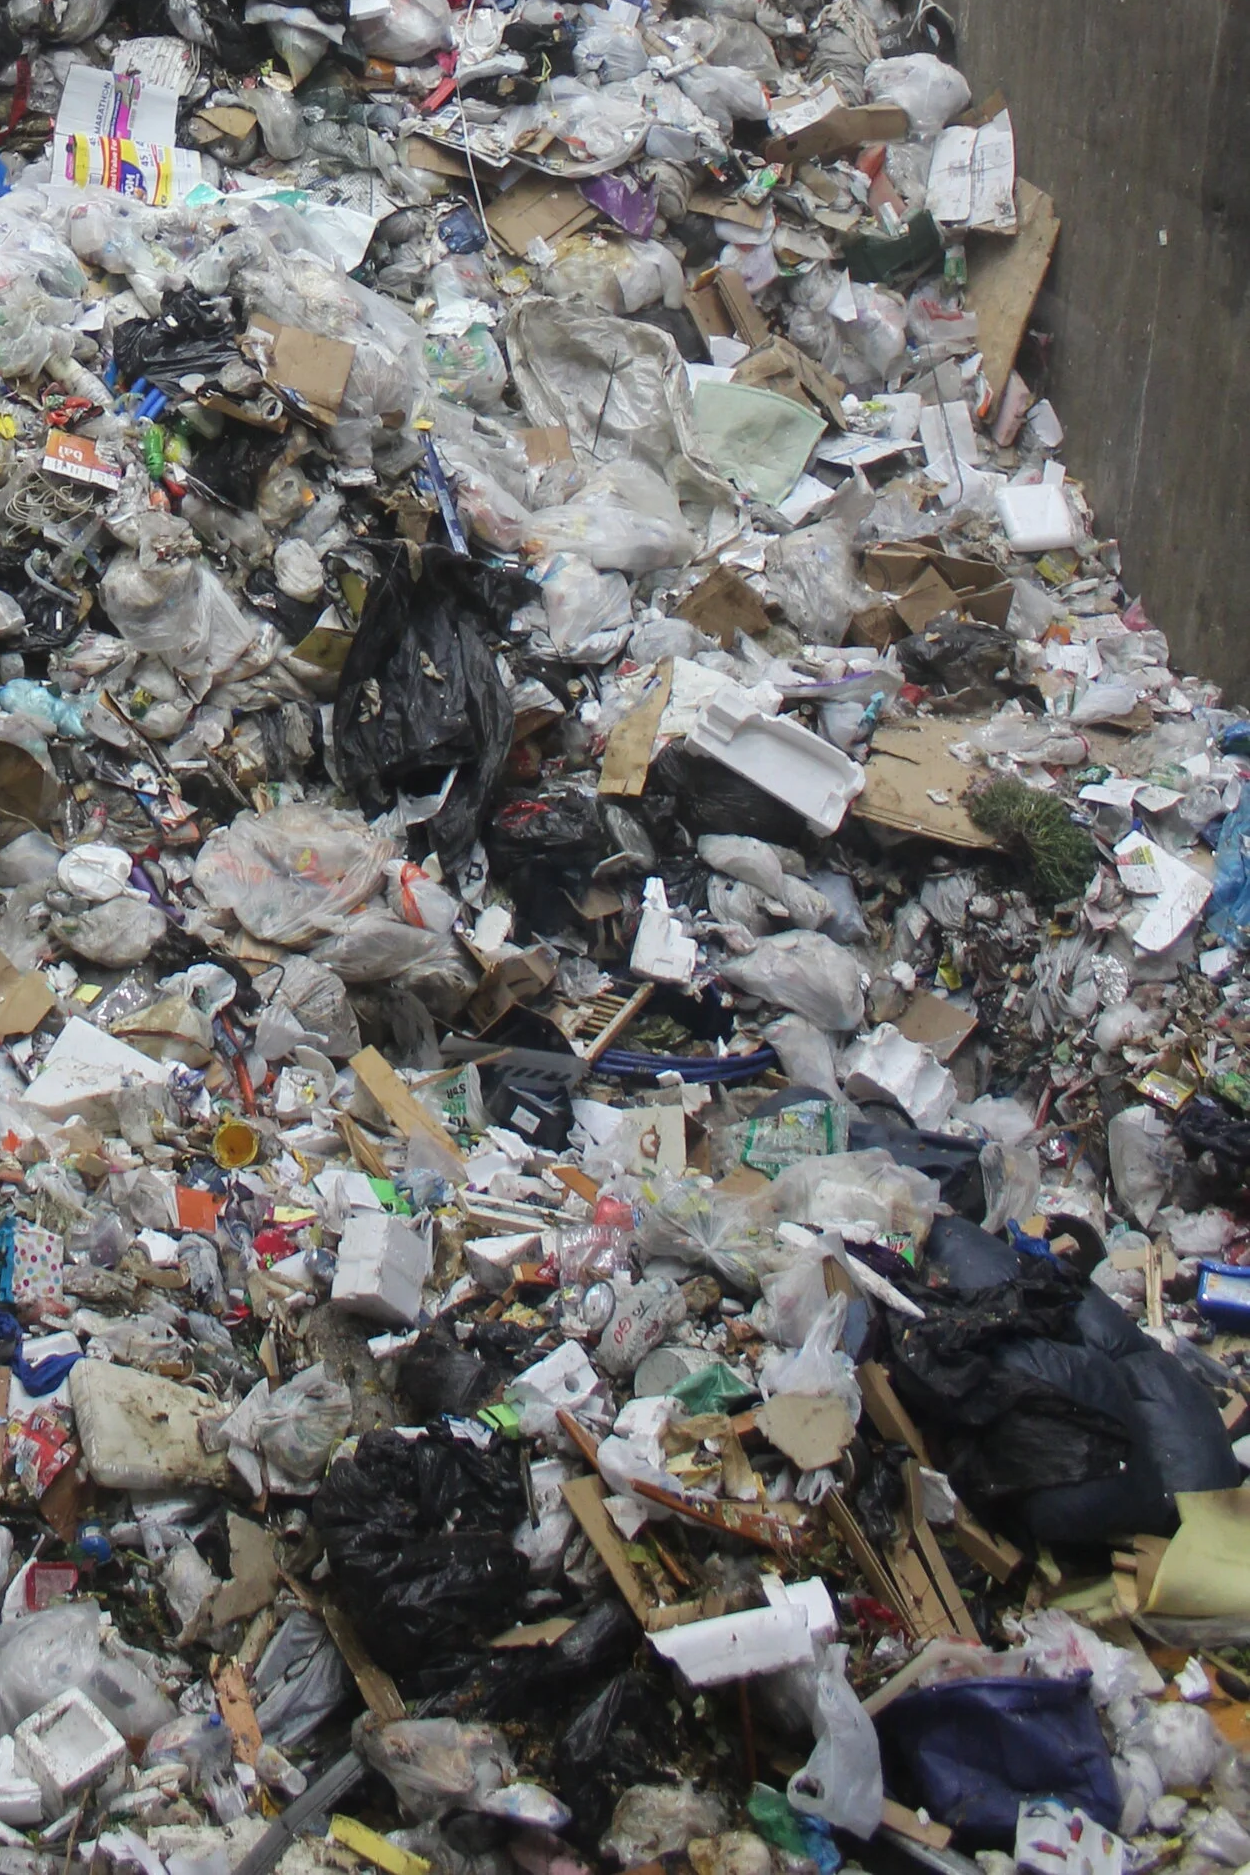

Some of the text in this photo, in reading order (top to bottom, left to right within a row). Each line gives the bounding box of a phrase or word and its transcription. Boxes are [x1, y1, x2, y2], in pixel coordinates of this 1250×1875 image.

[94, 81, 111, 134] MARATHON
[109, 139, 117, 151] For
[110, 153, 118, 174] Value
[58, 445, 83, 462] bai
